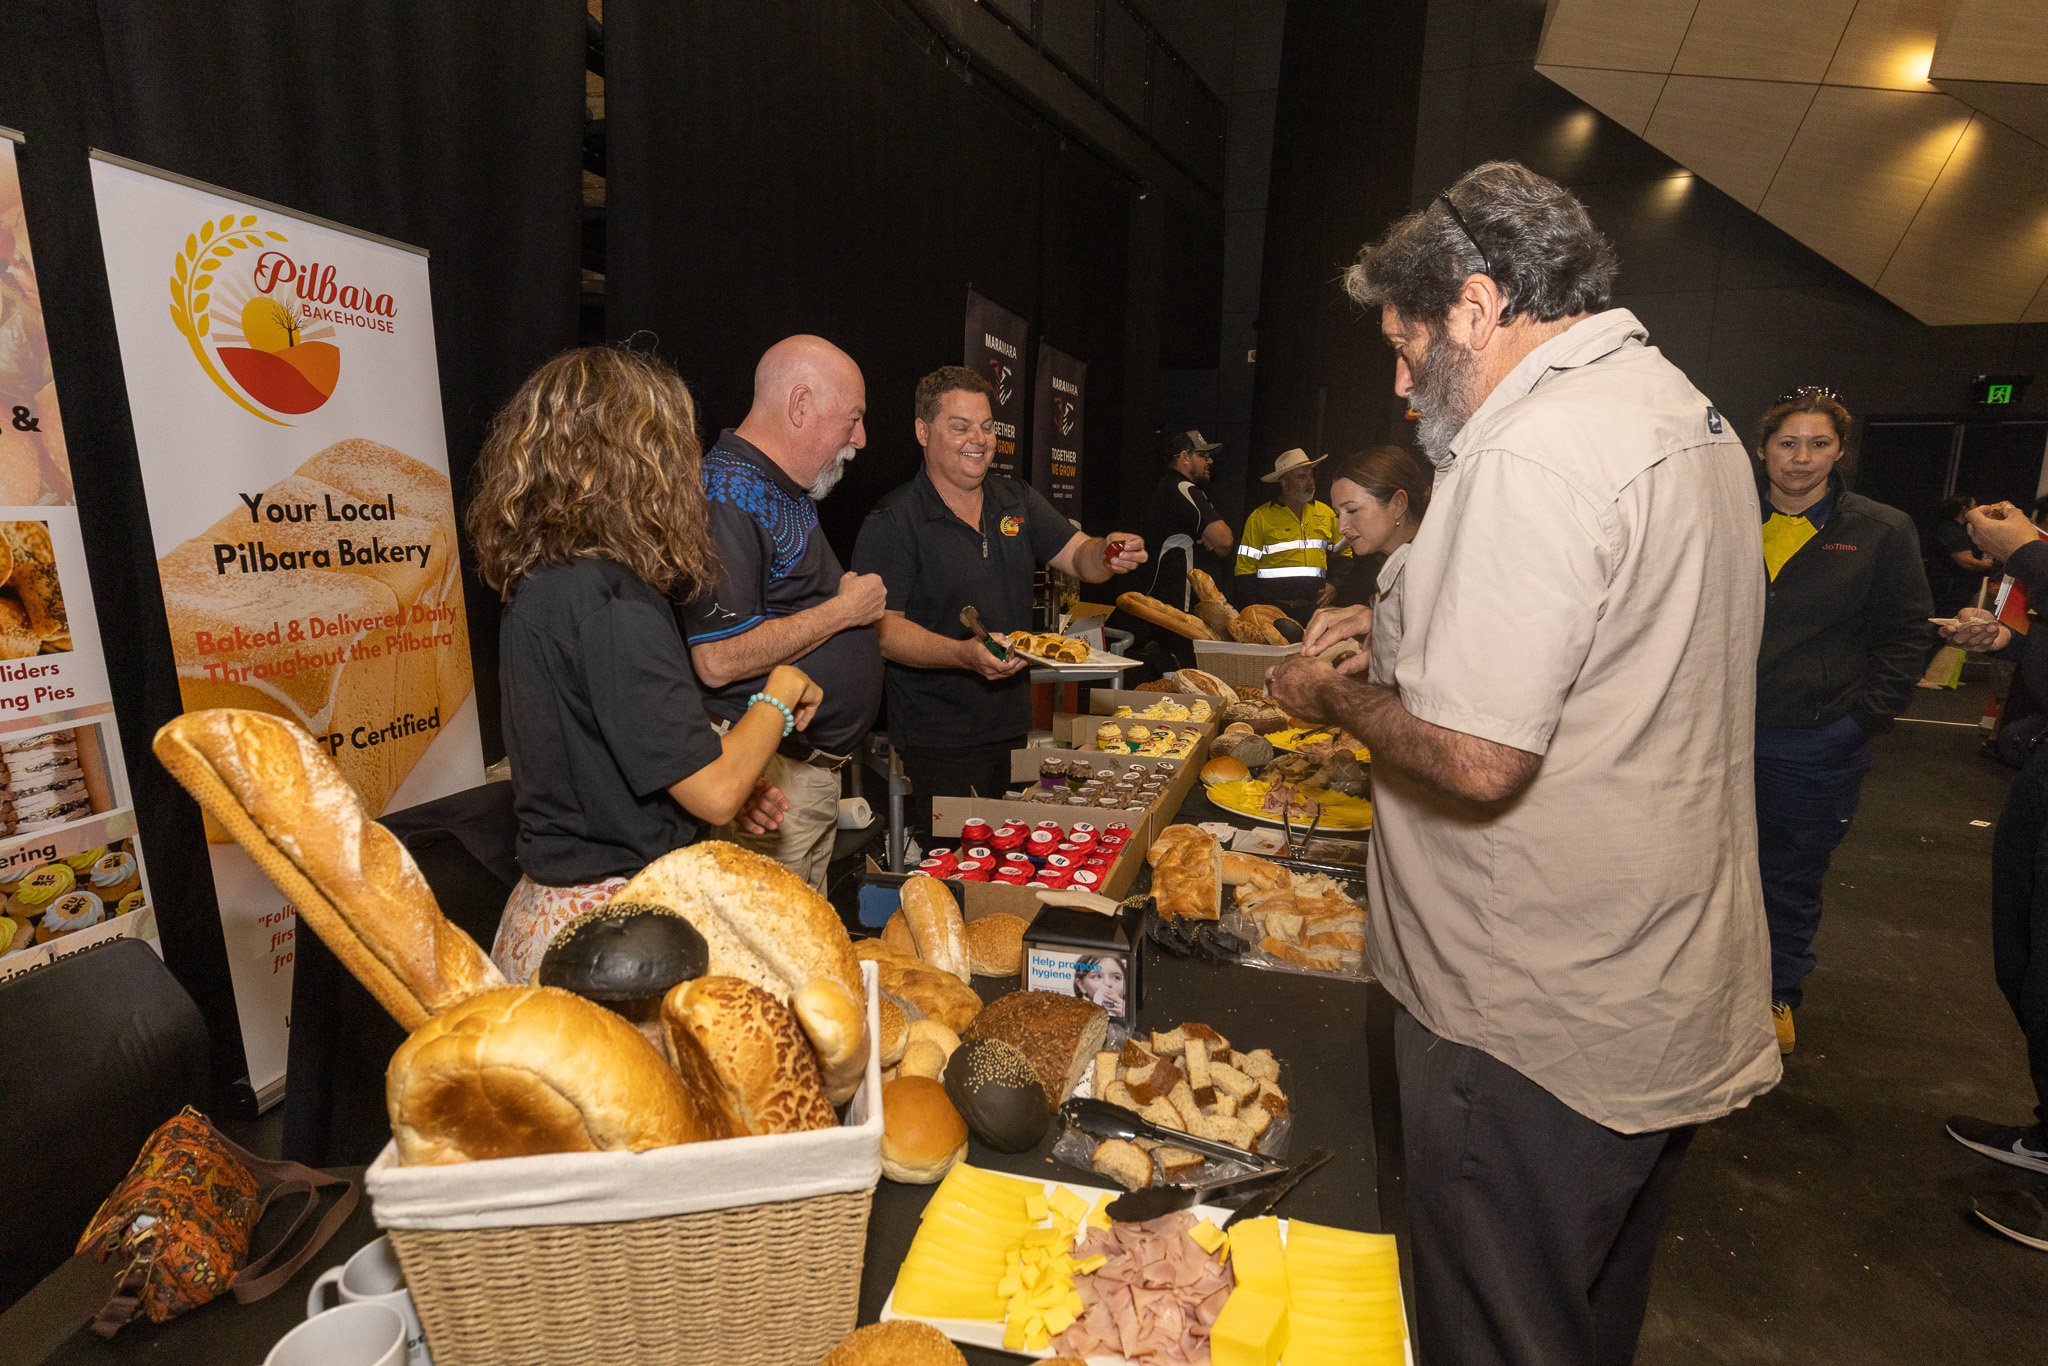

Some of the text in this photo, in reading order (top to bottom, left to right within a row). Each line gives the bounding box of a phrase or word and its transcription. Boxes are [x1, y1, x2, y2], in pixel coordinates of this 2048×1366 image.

[254, 251, 397, 318] Pilbara
[302, 304, 394, 333] BAKEHOUSE
[985, 333, 1017, 359] MARAMARA
[12, 405, 43, 432] &
[992, 421, 1015, 438] GETHER
[998, 440, 1015, 455] GROW
[1051, 447, 1076, 463] TOGETHER
[1060, 465, 1076, 477] GROW
[239, 493, 396, 523] Your Local
[213, 537, 432, 575] Pilbara Bakery
[195, 600, 457, 656] Baked & Delivered Daily
[203, 631, 454, 687] Throughout the Pilbara
[34, 686, 75, 703] Pies
[351, 706, 441, 749] Certified
[270, 928, 296, 953] firs
[1032, 956, 1102, 972] Help promote
[1032, 967, 1072, 979] hygiene
